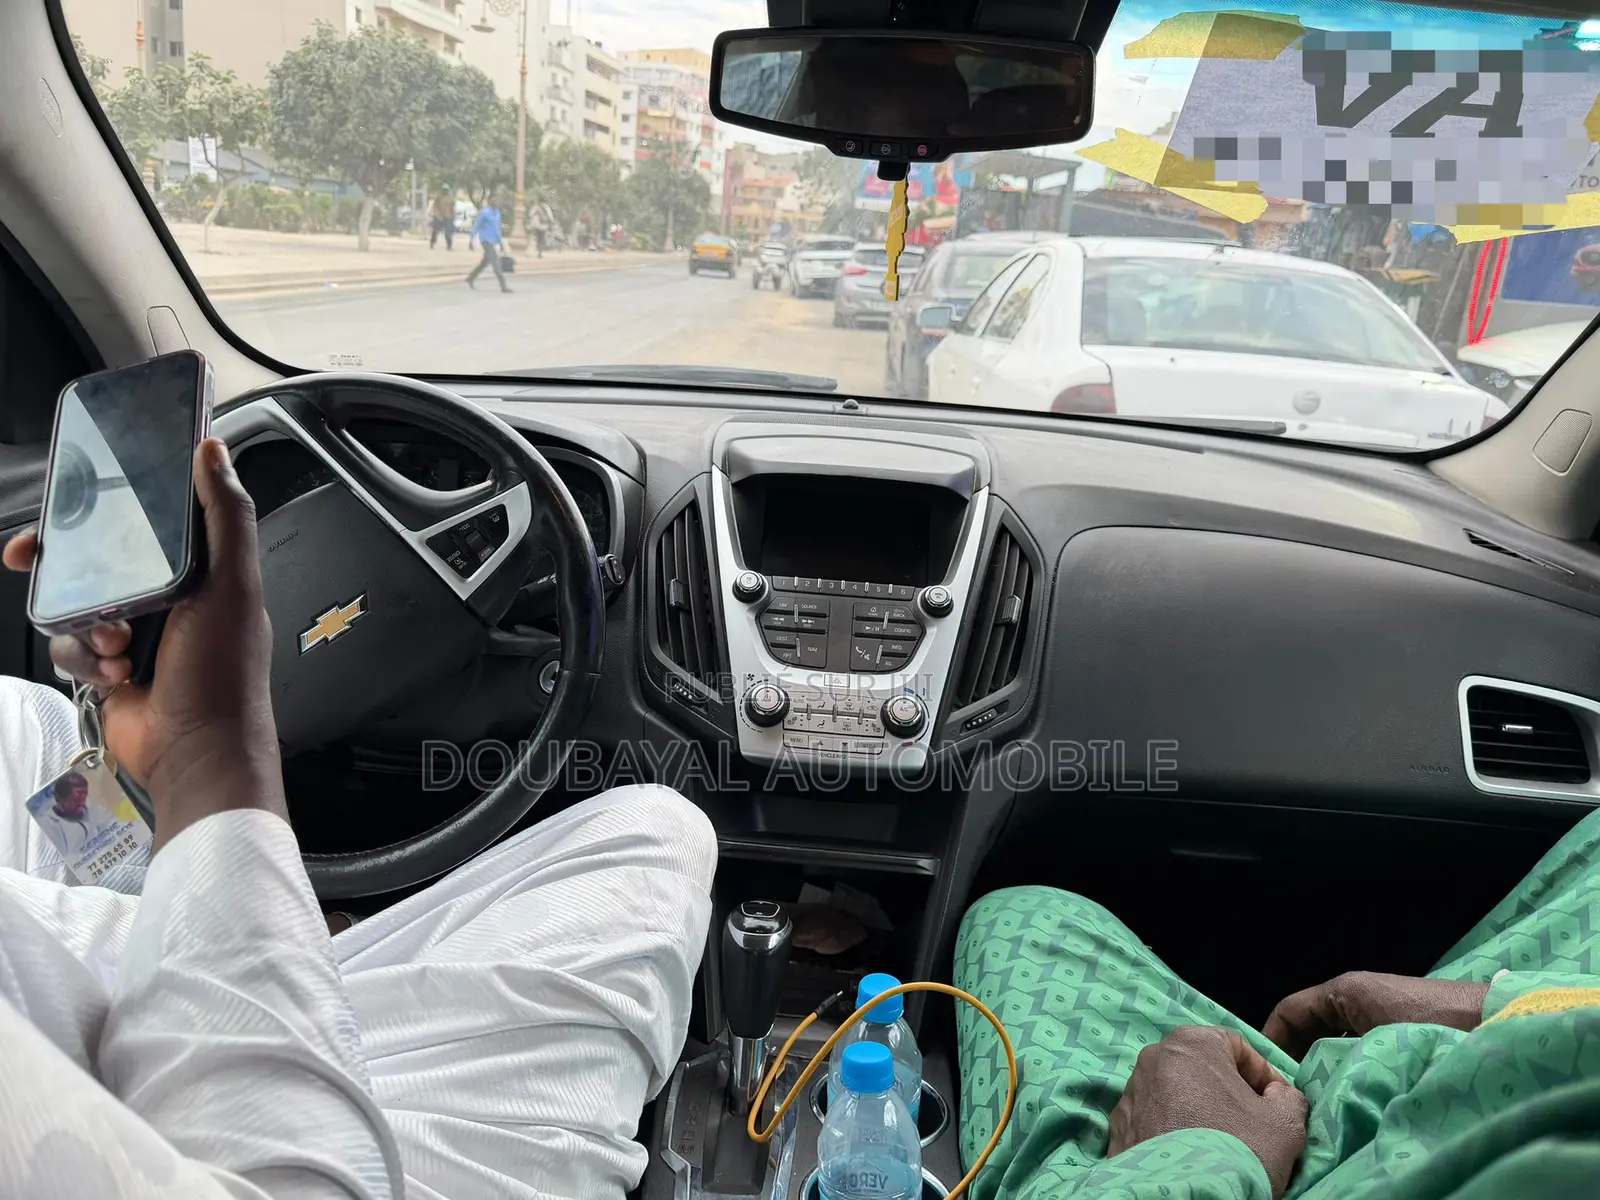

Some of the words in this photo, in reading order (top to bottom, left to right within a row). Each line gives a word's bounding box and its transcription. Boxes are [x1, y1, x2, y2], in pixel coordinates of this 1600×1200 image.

[87, 861, 97, 872] 77
[98, 851, 112, 865] 275
[113, 843, 123, 853] 65
[123, 834, 134, 845] 89
[92, 868, 103, 878] 78
[103, 857, 118, 870] 479
[117, 850, 127, 859] 10
[128, 841, 138, 850] 10
